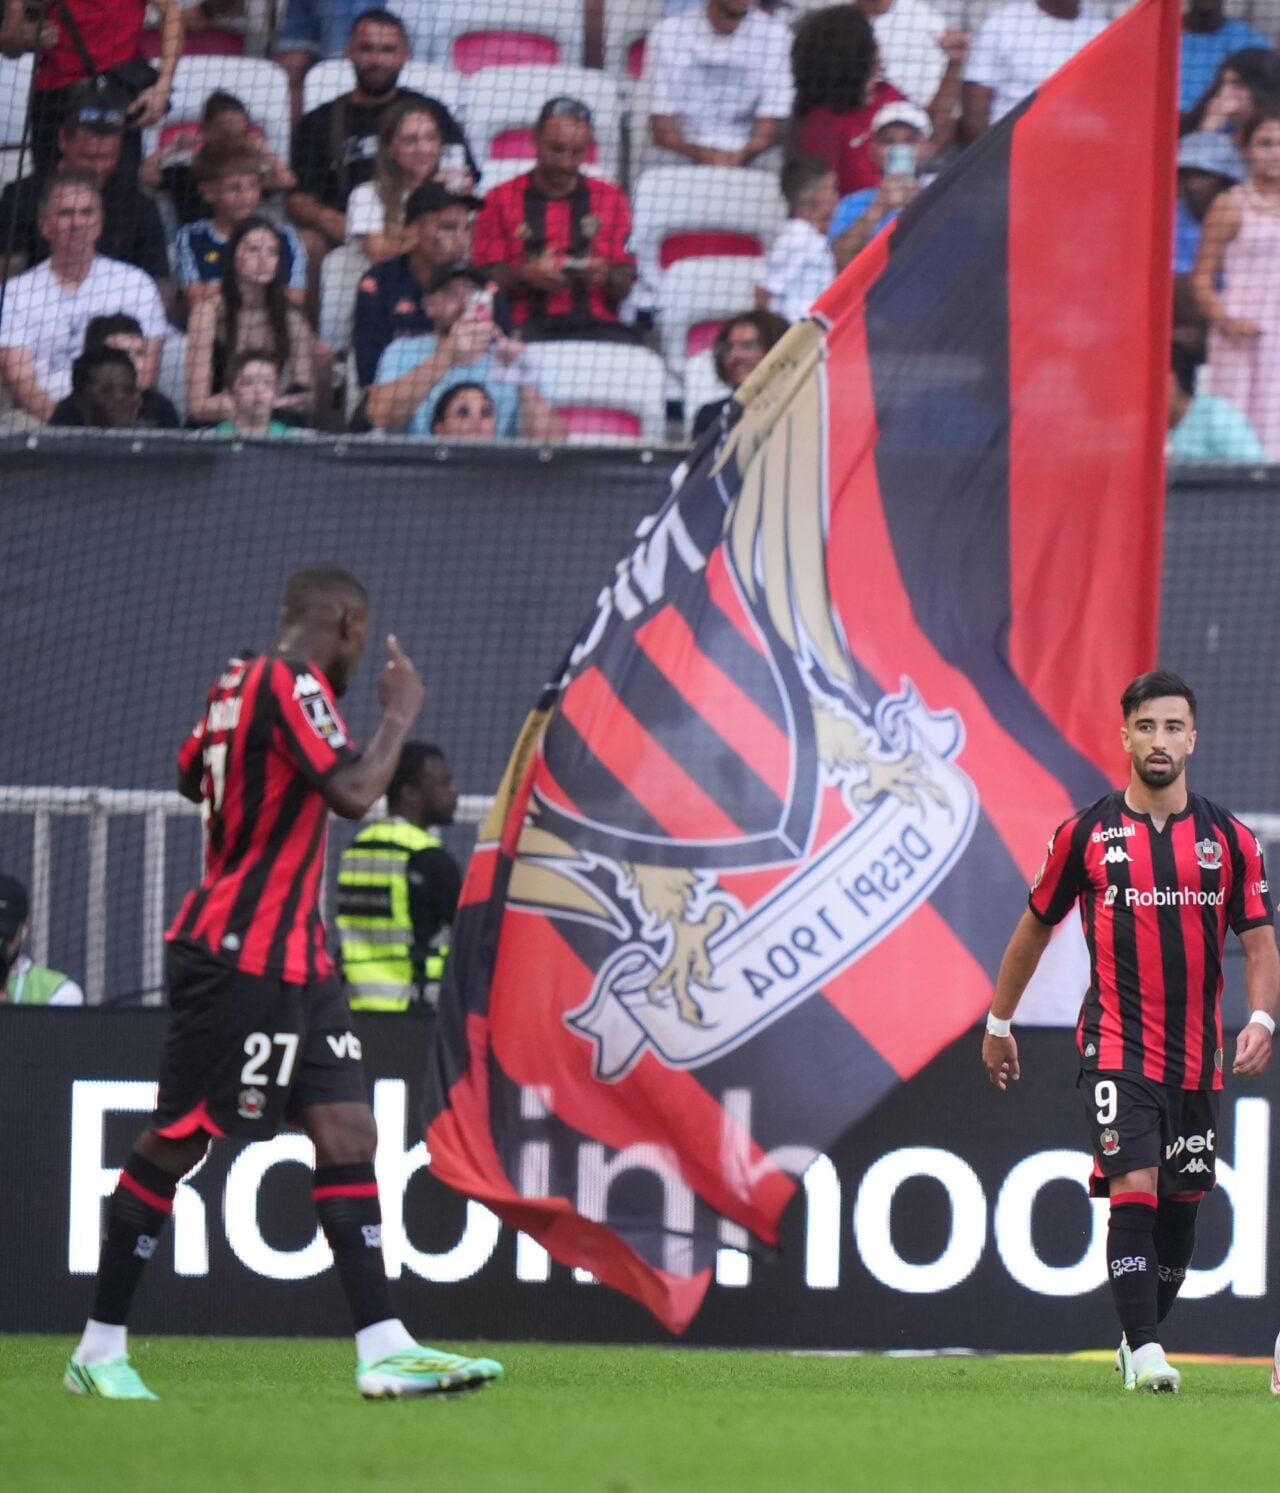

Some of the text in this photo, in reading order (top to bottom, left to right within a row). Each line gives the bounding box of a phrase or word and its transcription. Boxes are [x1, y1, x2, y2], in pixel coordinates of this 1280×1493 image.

[1091, 824, 1136, 844] actual
[1124, 885, 1226, 907] Robinhood
[240, 1031, 300, 1087] 27
[1094, 1080, 1118, 1126] 9
[68, 1077, 1270, 1301] Robinhood
